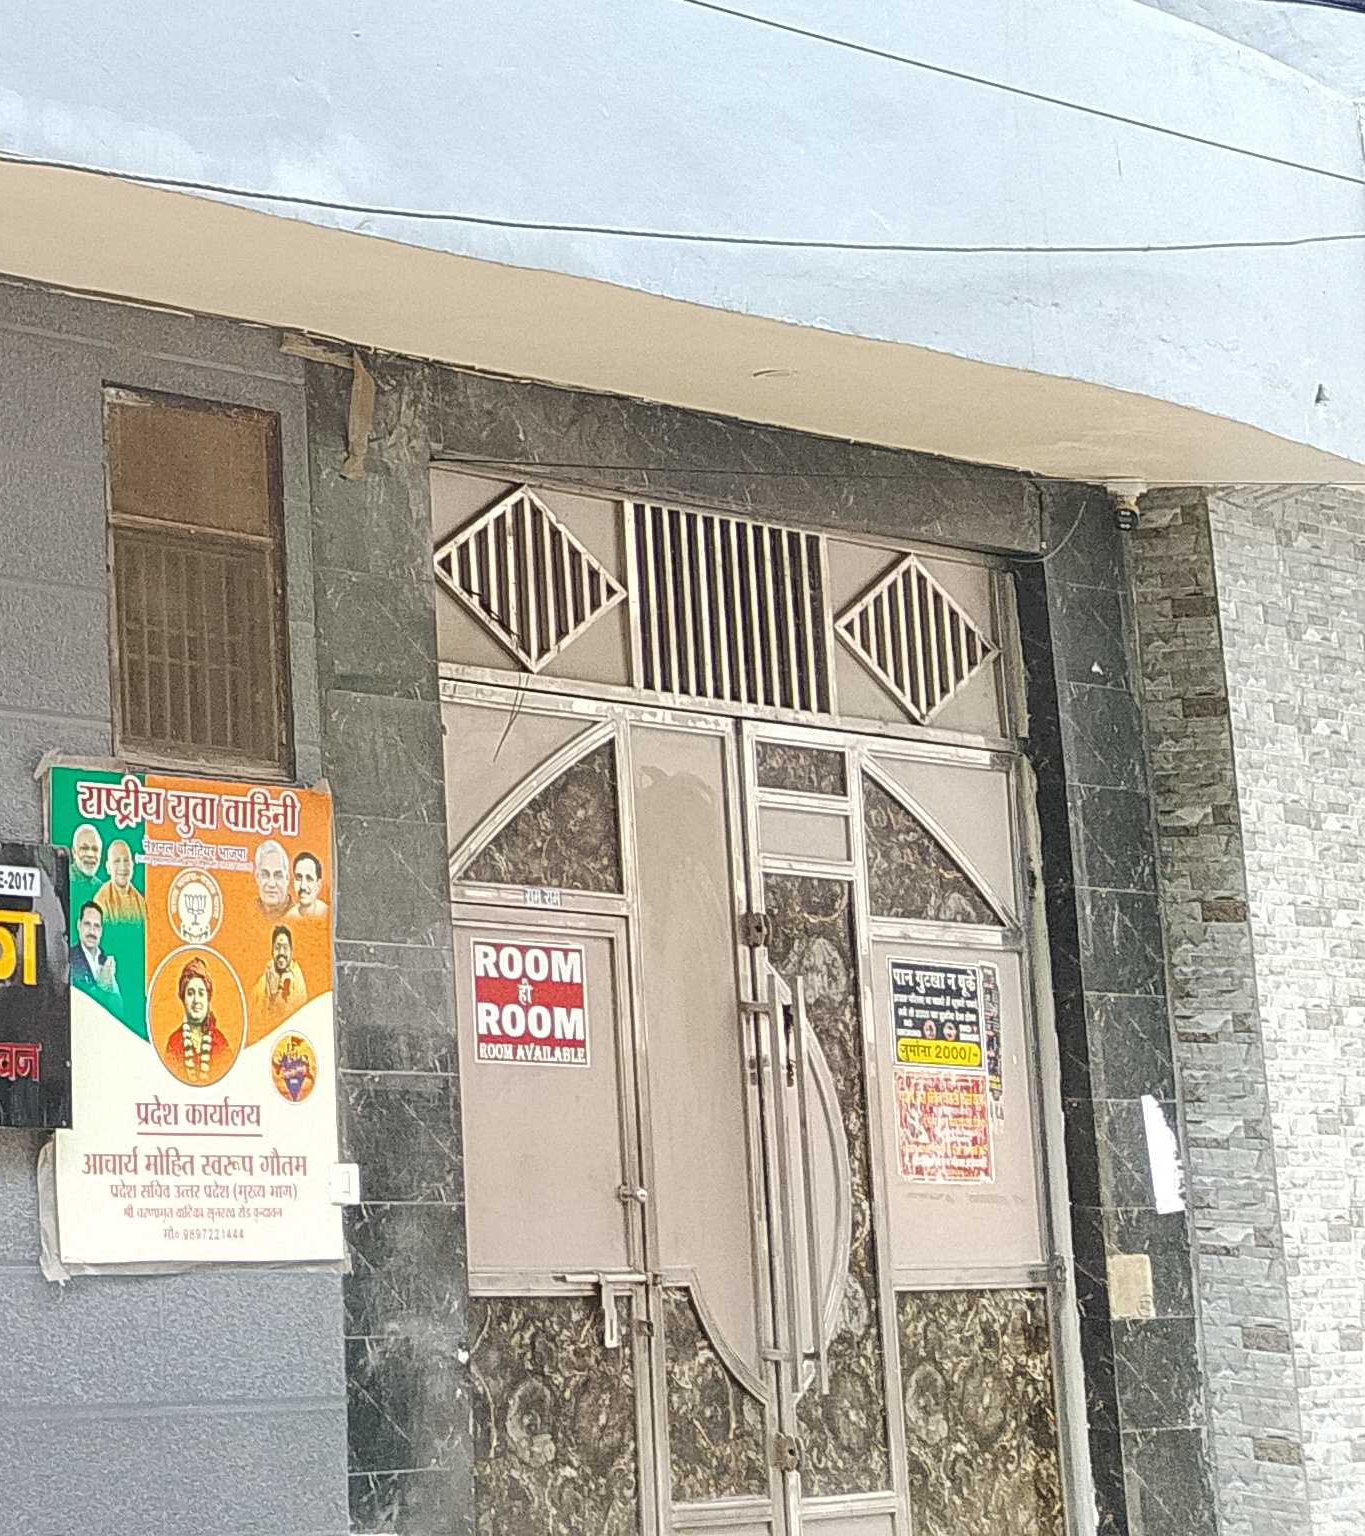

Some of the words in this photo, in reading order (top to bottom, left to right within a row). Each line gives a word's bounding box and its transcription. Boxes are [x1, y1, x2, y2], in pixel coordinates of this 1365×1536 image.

[78, 777, 164, 827] राष्ट्रीय
[168, 792, 217, 835] युवा
[222, 789, 299, 835] वाहिनी
[474, 944, 582, 983] ROOM
[518, 978, 533, 1005] ही
[892, 968, 914, 986] पान
[915, 970, 945, 994] गुटखा
[946, 973, 957, 990] न
[477, 1002, 585, 1040] ROOM
[479, 1042, 513, 1059] ROOM
[516, 1043, 586, 1063] AVAILABLE
[935, 1044, 979, 1063] 2000/-
[136, 1095, 179, 1127] प्रदेश
[185, 1096, 261, 1127] कार्यालय
[82, 1146, 139, 1176] आचार्य
[144, 1146, 195, 1177] मोहित
[200, 1155, 254, 1177] स्वरूप
[259, 1147, 307, 1177] गौतम
[110, 1179, 137, 1199] प्रदेश
